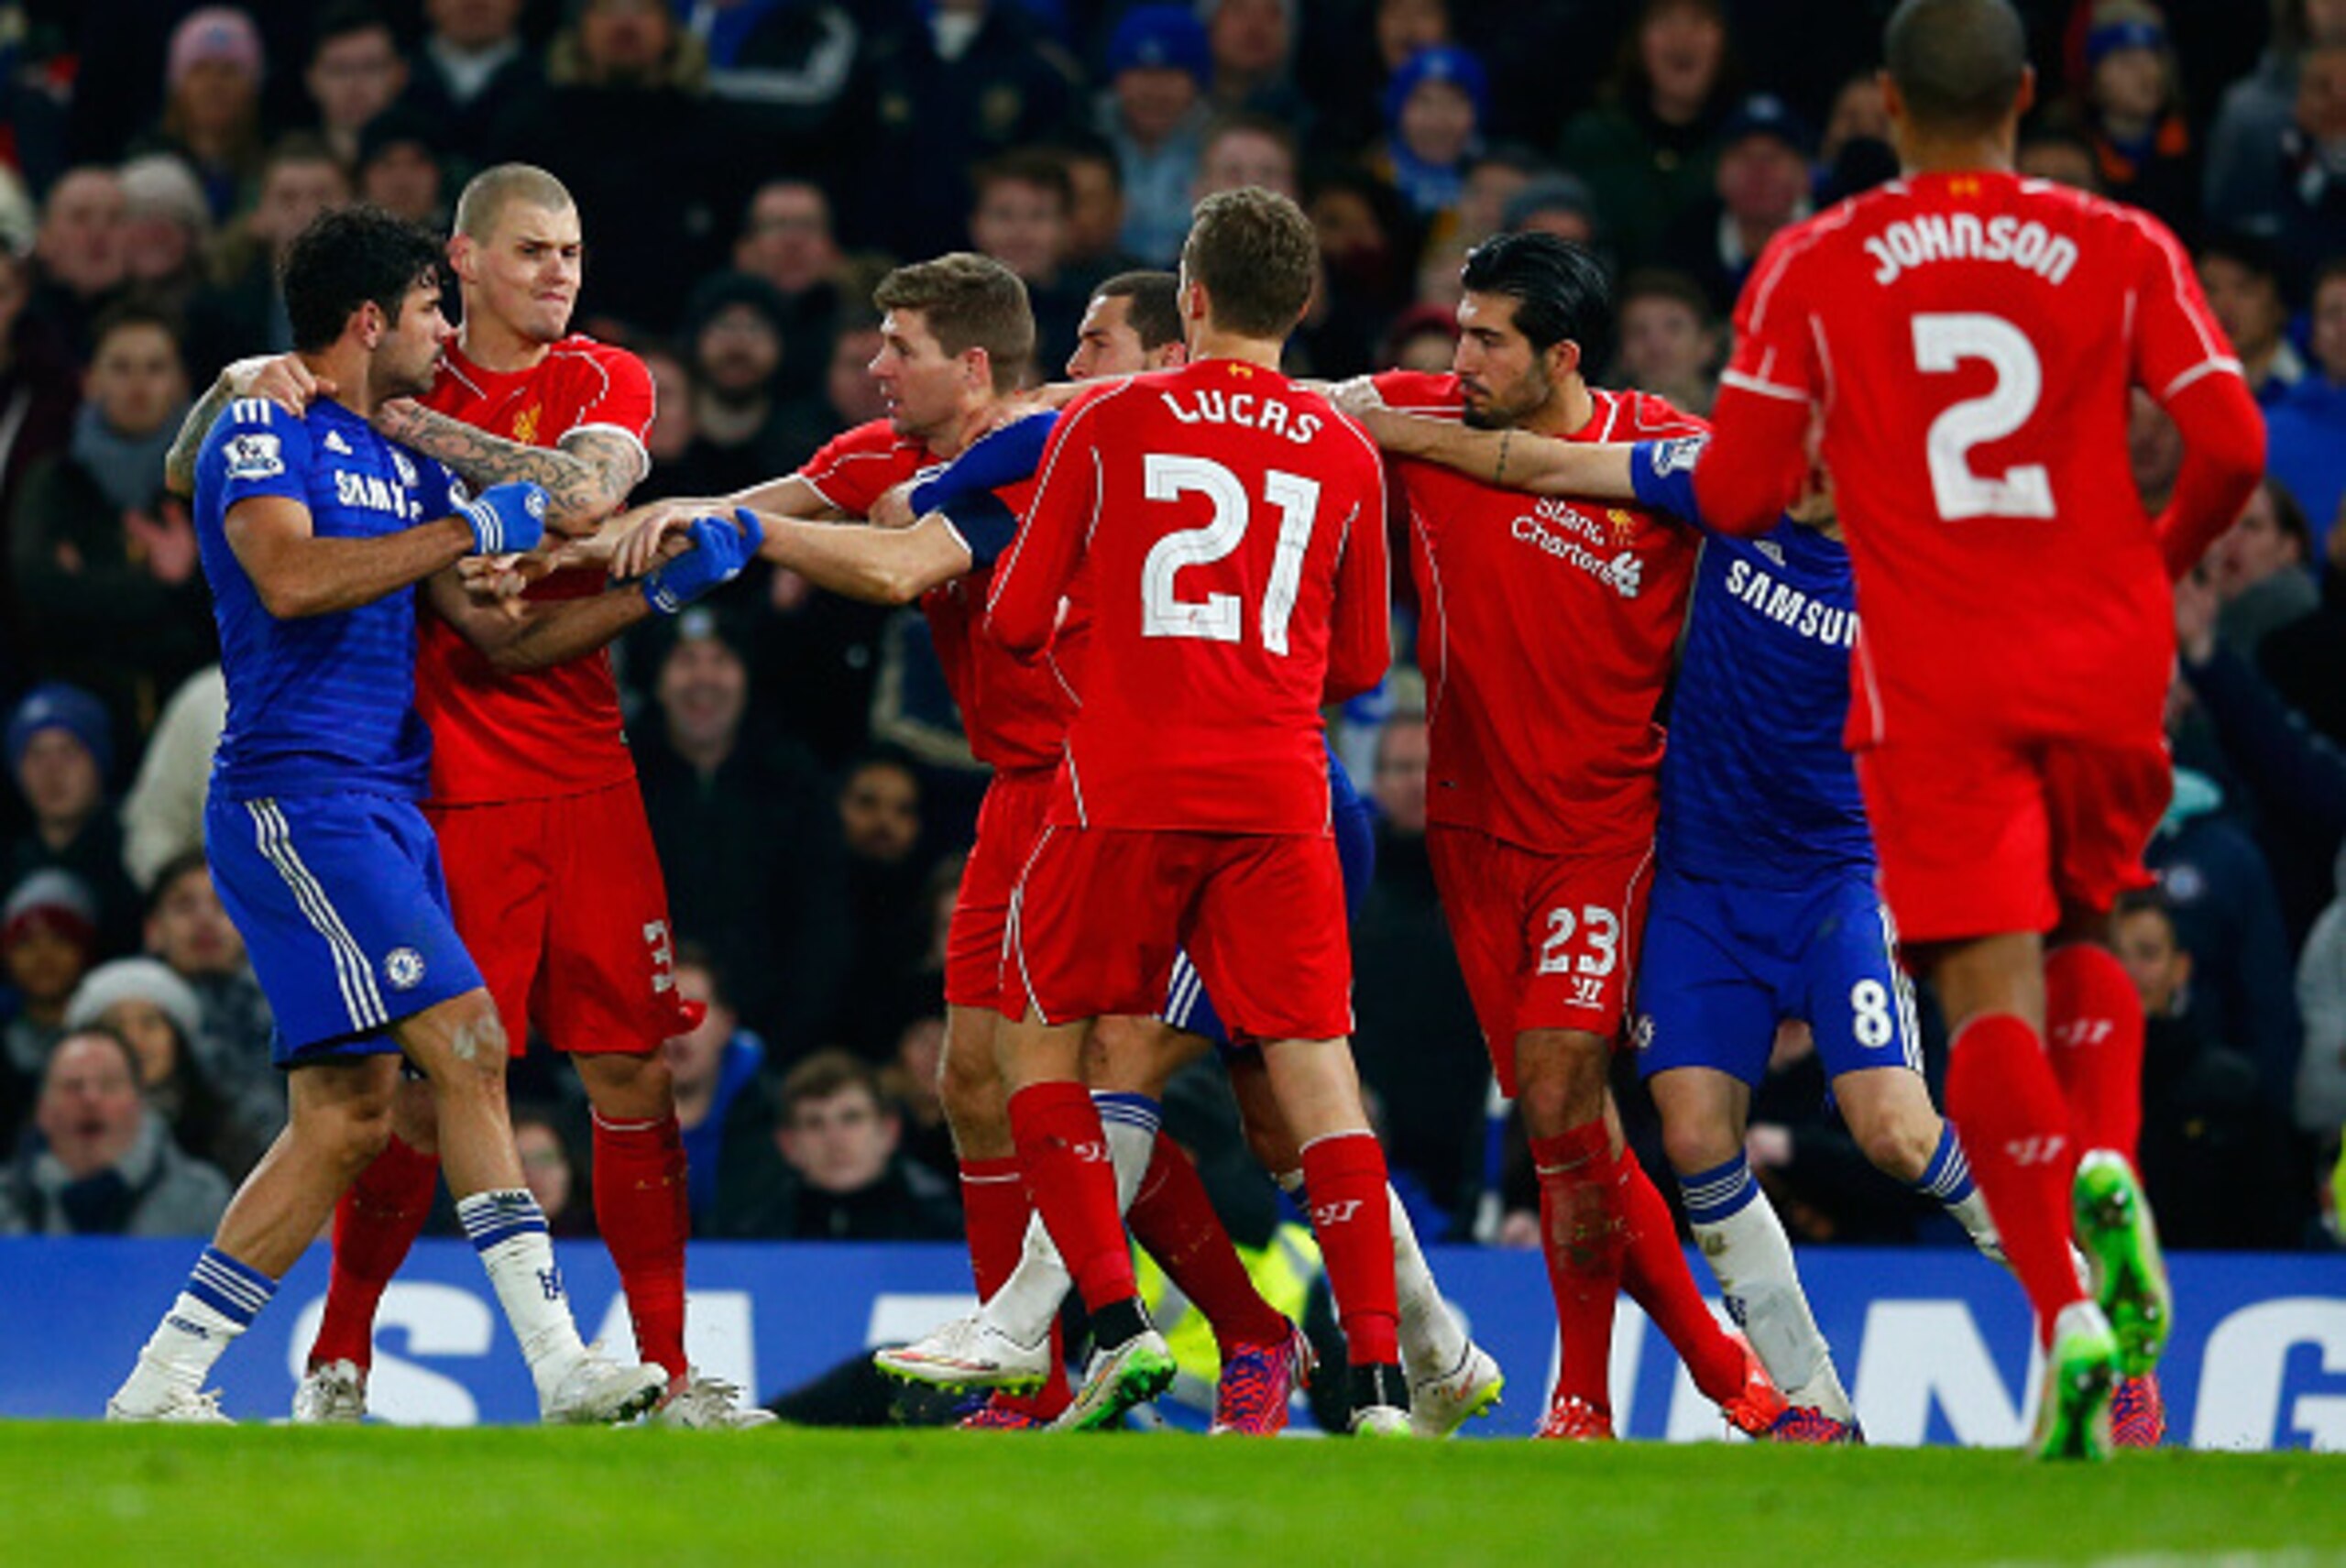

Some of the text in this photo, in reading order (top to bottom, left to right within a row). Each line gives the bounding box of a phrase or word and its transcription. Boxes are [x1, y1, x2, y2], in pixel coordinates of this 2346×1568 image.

[1160, 389, 1323, 444] LUCAS
[1911, 312, 2056, 521] 2
[1141, 454, 1321, 657] 21
[642, 919, 675, 993] 3
[1535, 904, 1621, 977] 23
[1850, 978, 1893, 1048] 8
